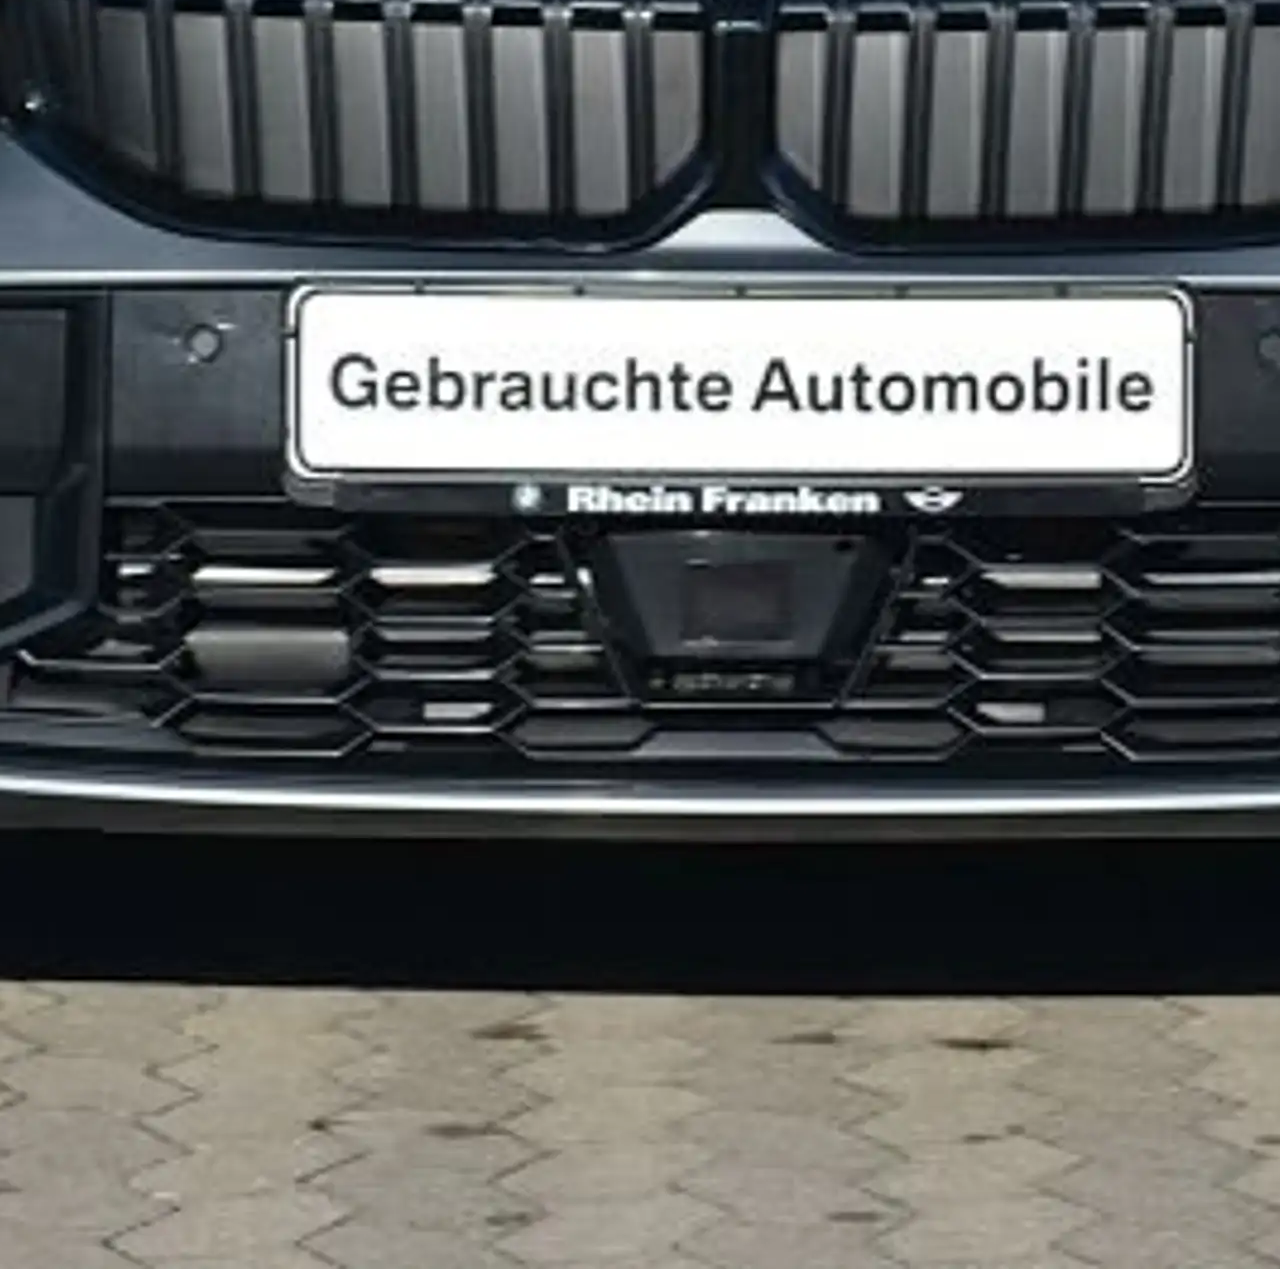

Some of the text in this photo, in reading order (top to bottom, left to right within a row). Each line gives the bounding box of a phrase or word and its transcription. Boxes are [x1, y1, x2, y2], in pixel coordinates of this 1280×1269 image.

[329, 351, 1154, 414] Gebrauchte Automobile
[566, 484, 882, 513] Rhein Franken
